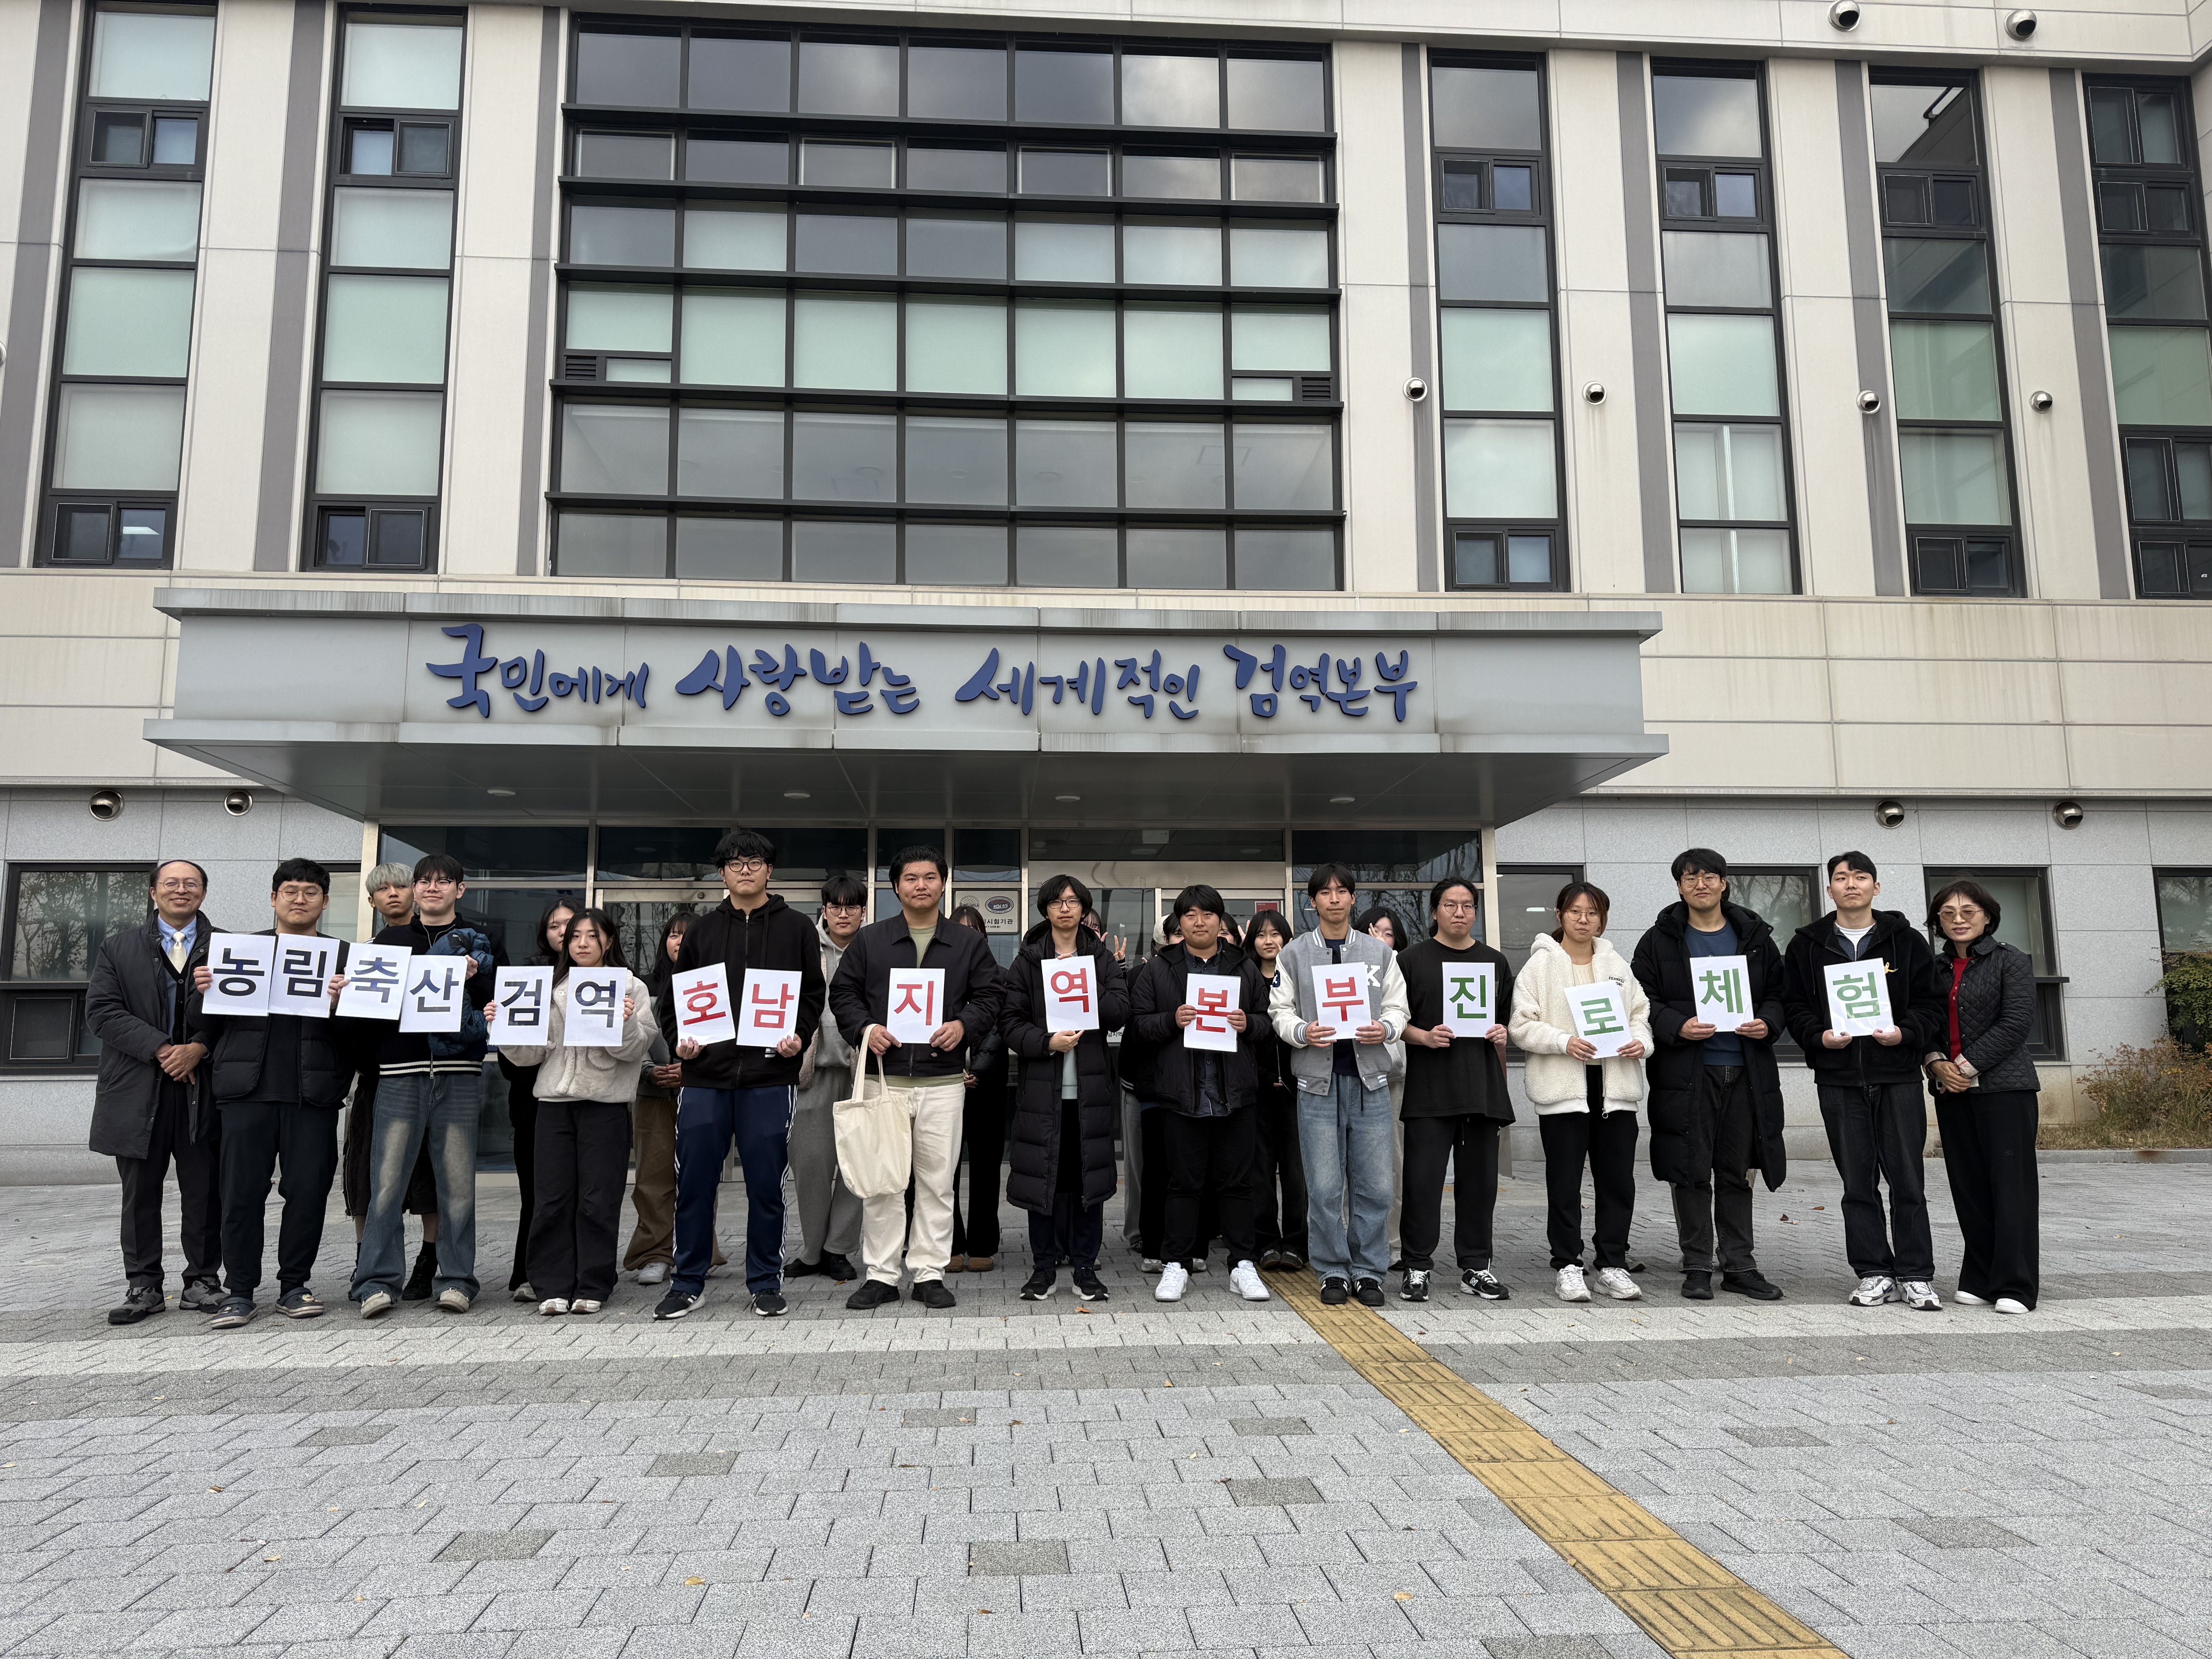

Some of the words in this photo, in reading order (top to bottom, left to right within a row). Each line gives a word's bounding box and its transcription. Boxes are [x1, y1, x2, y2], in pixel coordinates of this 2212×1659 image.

[426, 623, 649, 718] 국민에게
[675, 642, 920, 716] 사랑받는
[955, 647, 1200, 720] 세계적인
[1224, 644, 1418, 723] 검역본부
[213, 948, 264, 996] 농
[283, 949, 327, 998] 림
[350, 957, 399, 1003] 축
[410, 968, 459, 1012] 산
[1051, 968, 1089, 1013] 역
[1699, 968, 1743, 1013] 체
[501, 979, 542, 1025] 검
[575, 980, 616, 1028] 역
[683, 981, 726, 1026] 호
[752, 983, 794, 1029] 남
[894, 981, 934, 1026] 지
[1195, 988, 1231, 1033] 본
[1322, 977, 1364, 1022] 부
[1449, 975, 1487, 1019] 진
[1580, 998, 1624, 1036] 로
[1832, 972, 1881, 1019] 험
